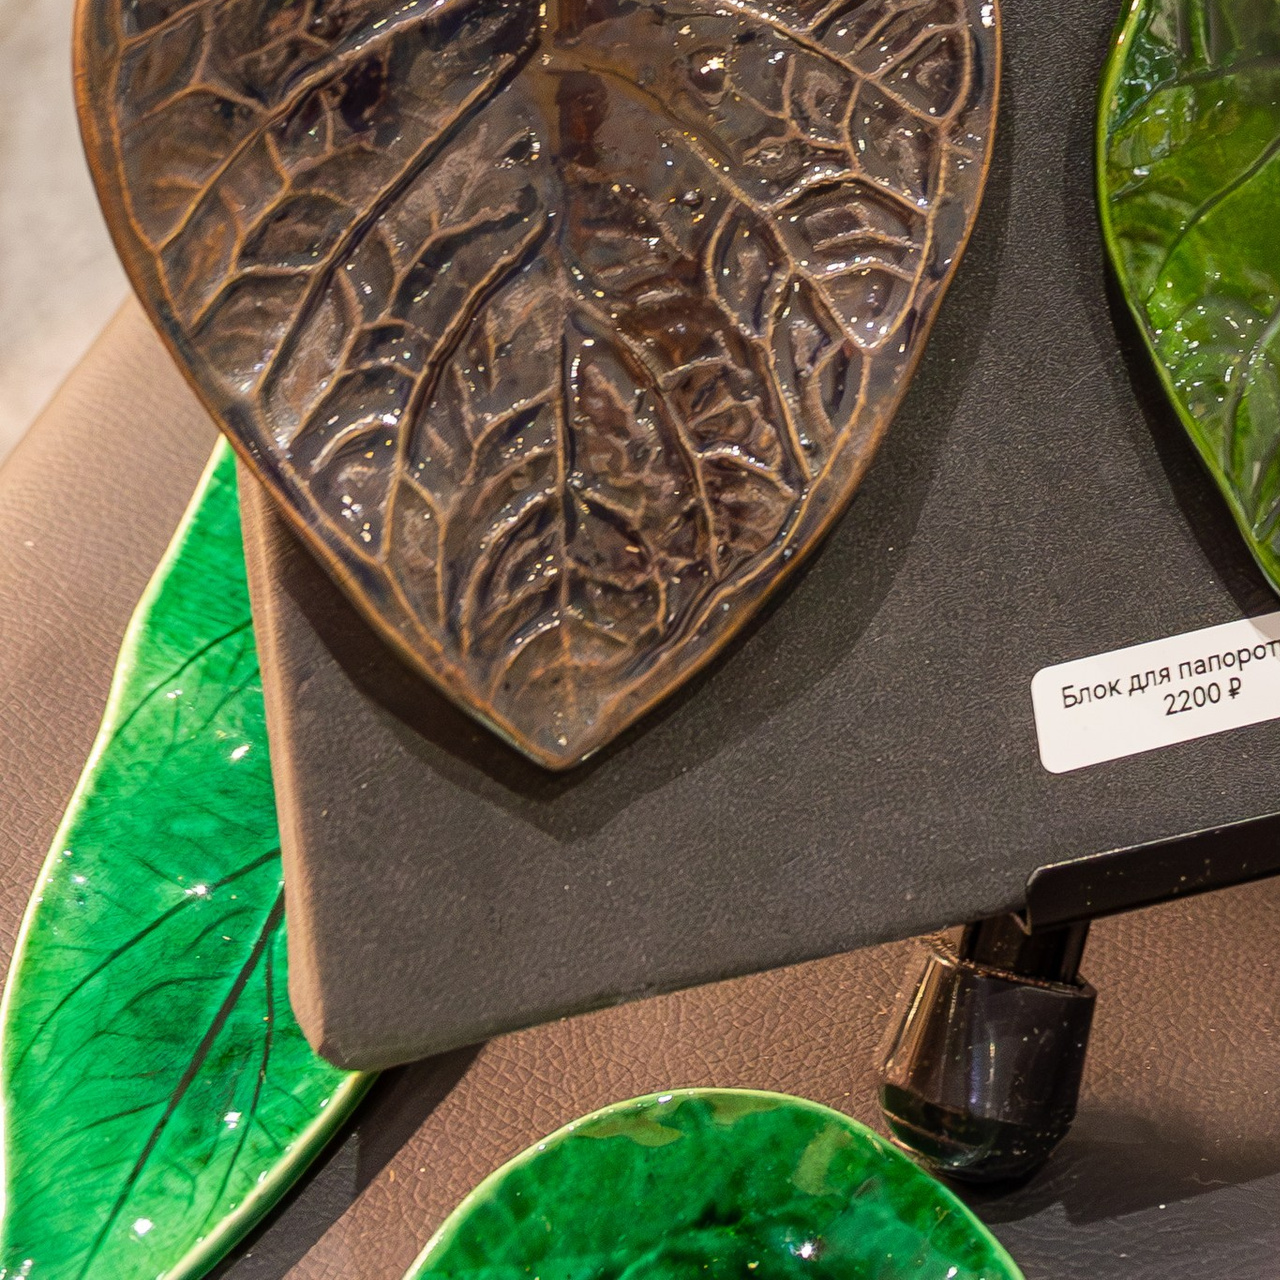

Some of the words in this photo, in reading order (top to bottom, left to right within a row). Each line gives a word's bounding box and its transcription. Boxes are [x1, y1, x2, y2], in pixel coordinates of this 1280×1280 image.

[1061, 678, 1122, 709] Блок
[1129, 666, 1172, 694] для
[1163, 682, 1221, 717] 2200
